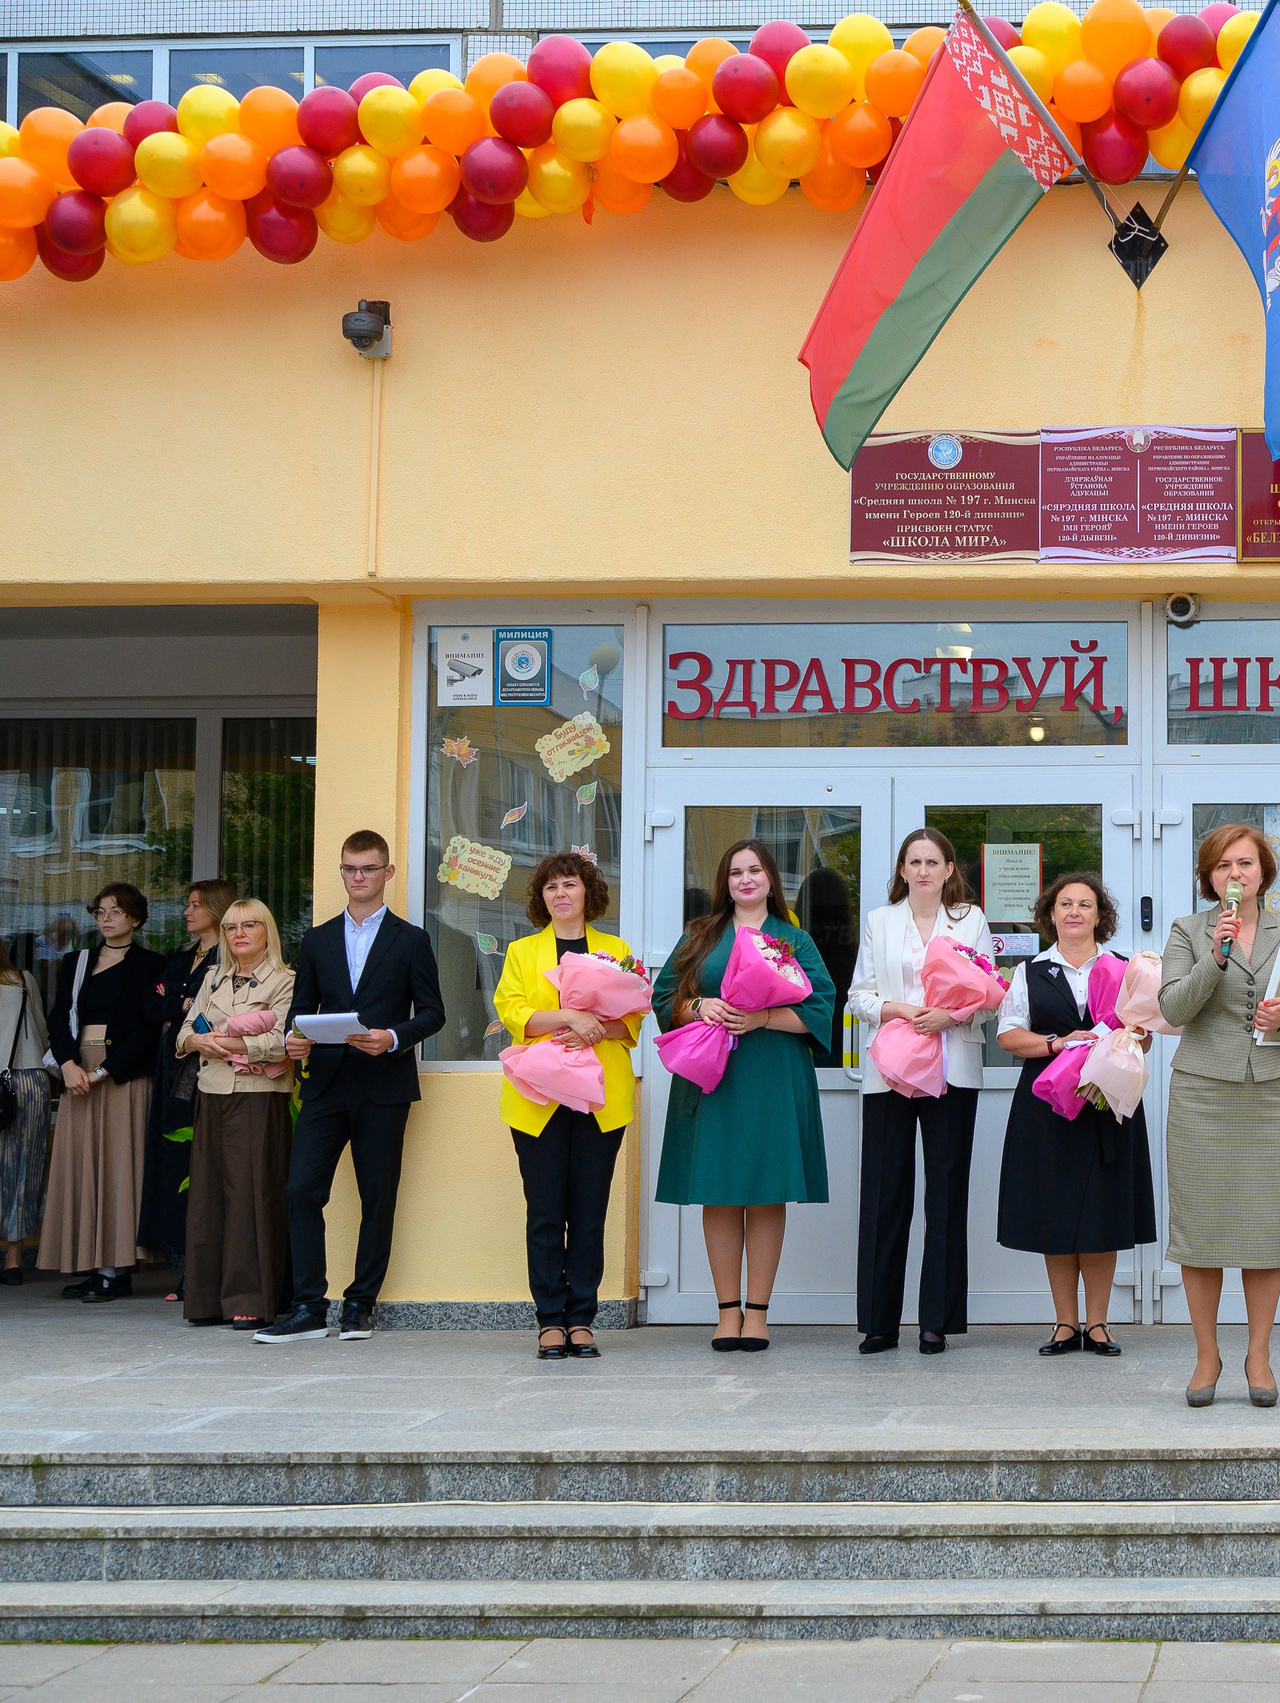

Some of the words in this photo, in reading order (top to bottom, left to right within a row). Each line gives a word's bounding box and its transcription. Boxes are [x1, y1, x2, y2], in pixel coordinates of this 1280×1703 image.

[895, 472, 996, 481] ГОСУДАРСТВЕННОМУ
[875, 482, 944, 491] УЧРЕЖДЕНИЮ
[946, 482, 1015, 490] ОБРАЗОВАНИЯ
[854, 496, 905, 507] «Средняя
[946, 496, 957, 505] №
[961, 495, 980, 505] 197
[994, 495, 1036, 505] Минска
[1042, 503, 1097, 512] «СЯРЭДНЯЯ
[1100, 503, 1136, 511] ШКОЛА
[1141, 503, 1194, 511] «СРЕДНЯЯ
[1195, 502, 1234, 510] ШКОЛА
[903, 510, 941, 520] Героев
[944, 510, 971, 518] 120-й
[974, 511, 1025, 519] дивизии»
[1089, 514, 1129, 522] МІНСКА
[1185, 513, 1229, 521] МИНСКА
[897, 525, 953, 533] ПРИСВОЕН
[882, 535, 951, 547] «ШКОЛА
[955, 535, 1007, 547] МИРА»
[498, 631, 549, 640] МИЛИЦИЯ
[667, 639, 1124, 725] ЗДРАВСТВУЙ,
[554, 724, 577, 740] Буду
[467, 857, 501, 874] осенние
